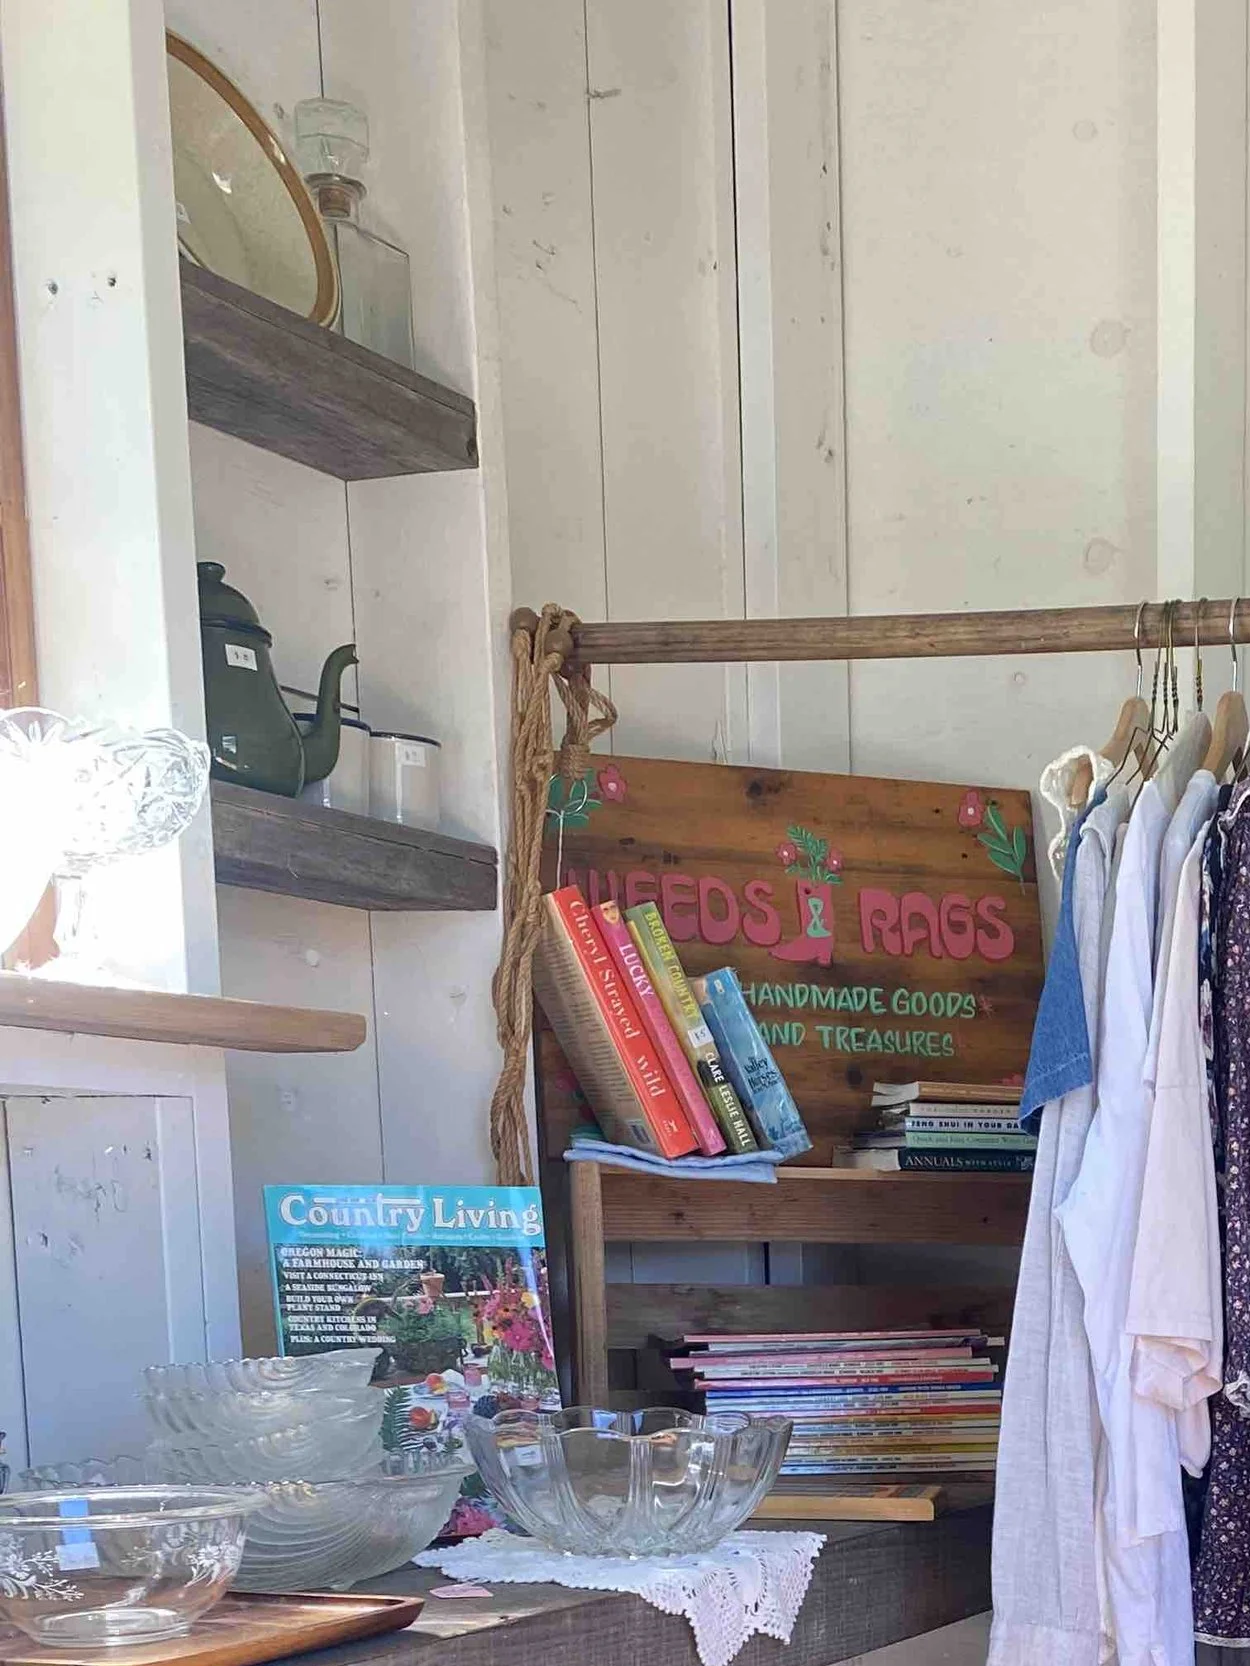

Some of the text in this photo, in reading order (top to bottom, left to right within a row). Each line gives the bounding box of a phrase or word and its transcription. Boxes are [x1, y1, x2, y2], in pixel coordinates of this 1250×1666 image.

[562, 868, 782, 946] EEDS
[858, 887, 1015, 962] RAGS
[569, 900, 641, 1039] Cheryl Strayed
[618, 943, 655, 997] LUCKY
[644, 911, 699, 1019] BROKEN COUNTRY
[741, 982, 887, 1015] HANDMADE
[891, 988, 976, 1019] GOODS
[758, 1022, 956, 1057] AND TREASURES
[705, 1052, 751, 1147] CLARE LESLIE HALL
[905, 1156, 964, 1168] ANNUALS
[279, 1192, 542, 1236] Country Living
[281, 1247, 324, 1258] OREGON
[283, 1259, 424, 1269] A FARMHOUSE AND GARDEN
[285, 1283, 372, 1292] A SEASIDE BUNGALOW
[314, 1272, 368, 1280] CONNECTICUT
[368, 1273, 384, 1281] INN
[286, 1295, 311, 1303] BUILD
[288, 1315, 325, 1323] COUNTRY
